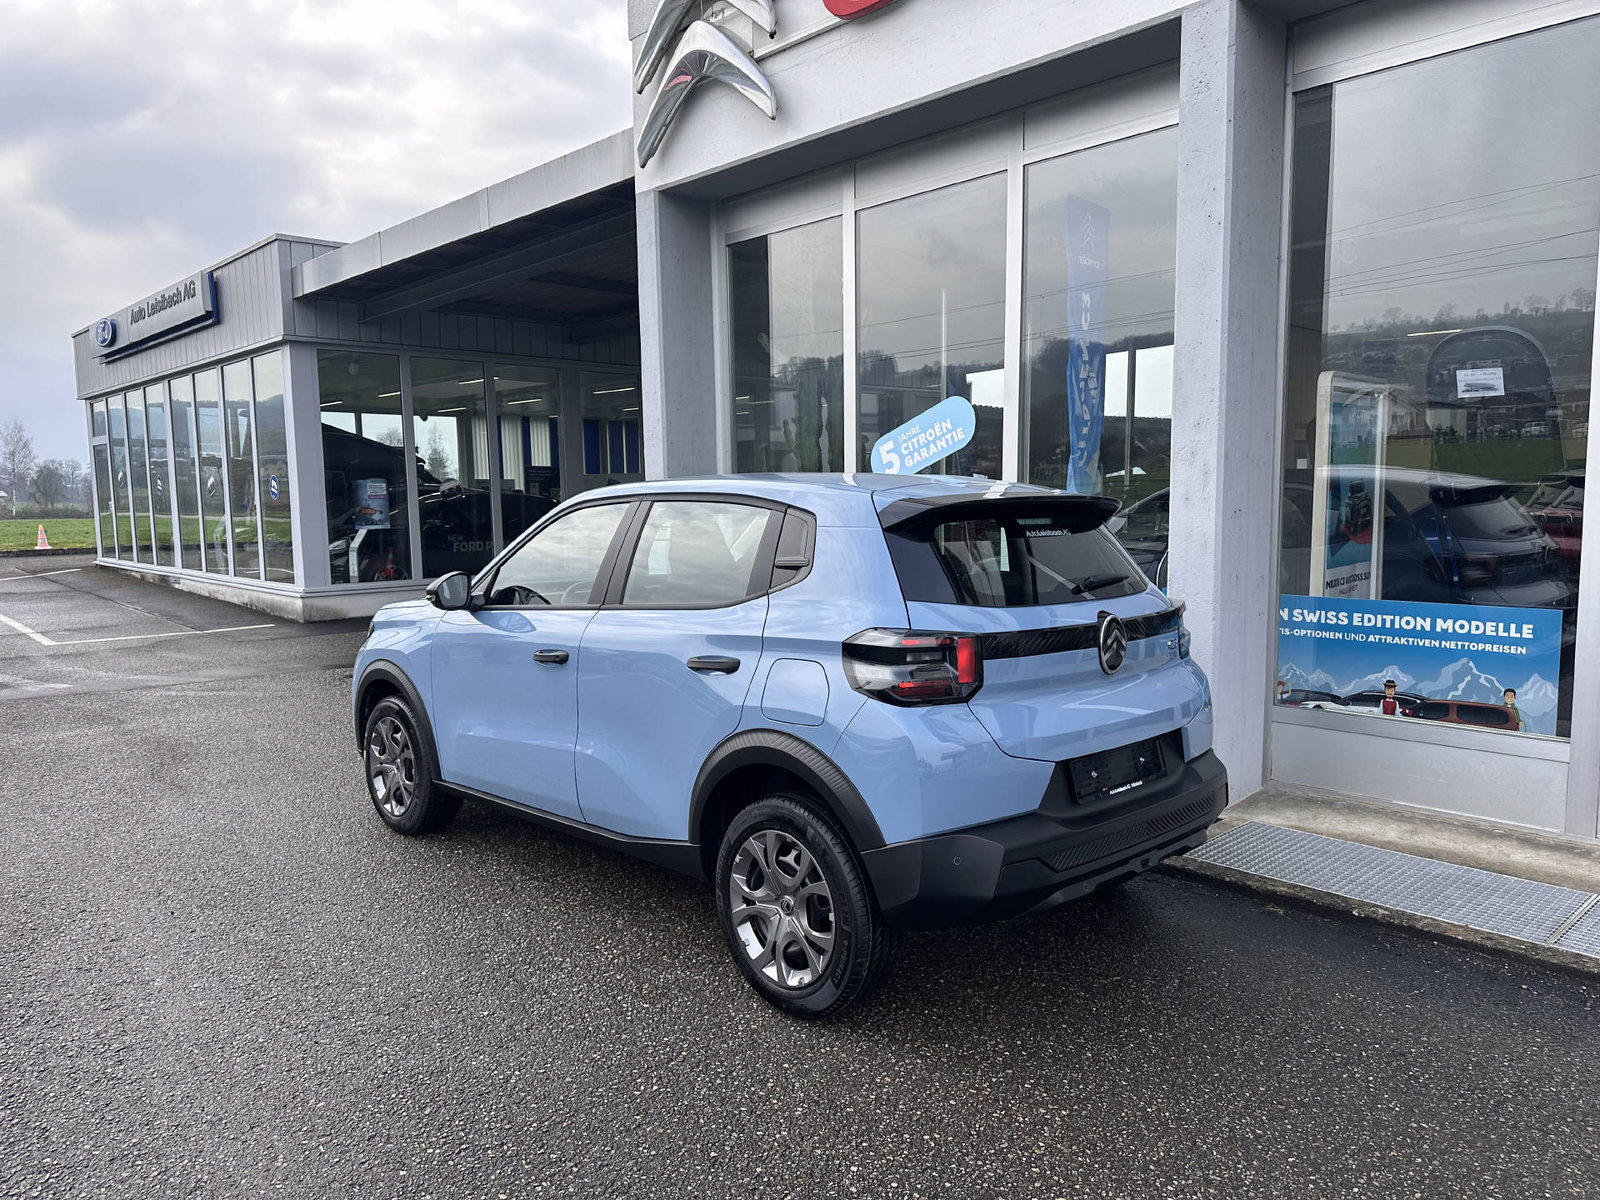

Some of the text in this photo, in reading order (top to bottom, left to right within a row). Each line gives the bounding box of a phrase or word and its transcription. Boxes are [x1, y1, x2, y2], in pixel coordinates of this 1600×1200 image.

[130, 280, 196, 325] Auto Leisibach AG
[899, 425, 921, 443] JAHRE
[901, 420, 952, 454] CITROËN
[905, 428, 964, 467] GARANTIE
[879, 441, 900, 474] 5
[453, 541, 484, 553] FORD
[1292, 608, 1349, 626] SWISS
[1352, 612, 1432, 632] EDITION
[1435, 617, 1534, 639] MODELLE
[1344, 632, 1367, 642] UND
[1367, 634, 1439, 648] ATTRAKTIVEN
[1441, 640, 1527, 655] NETTOPREISEN
